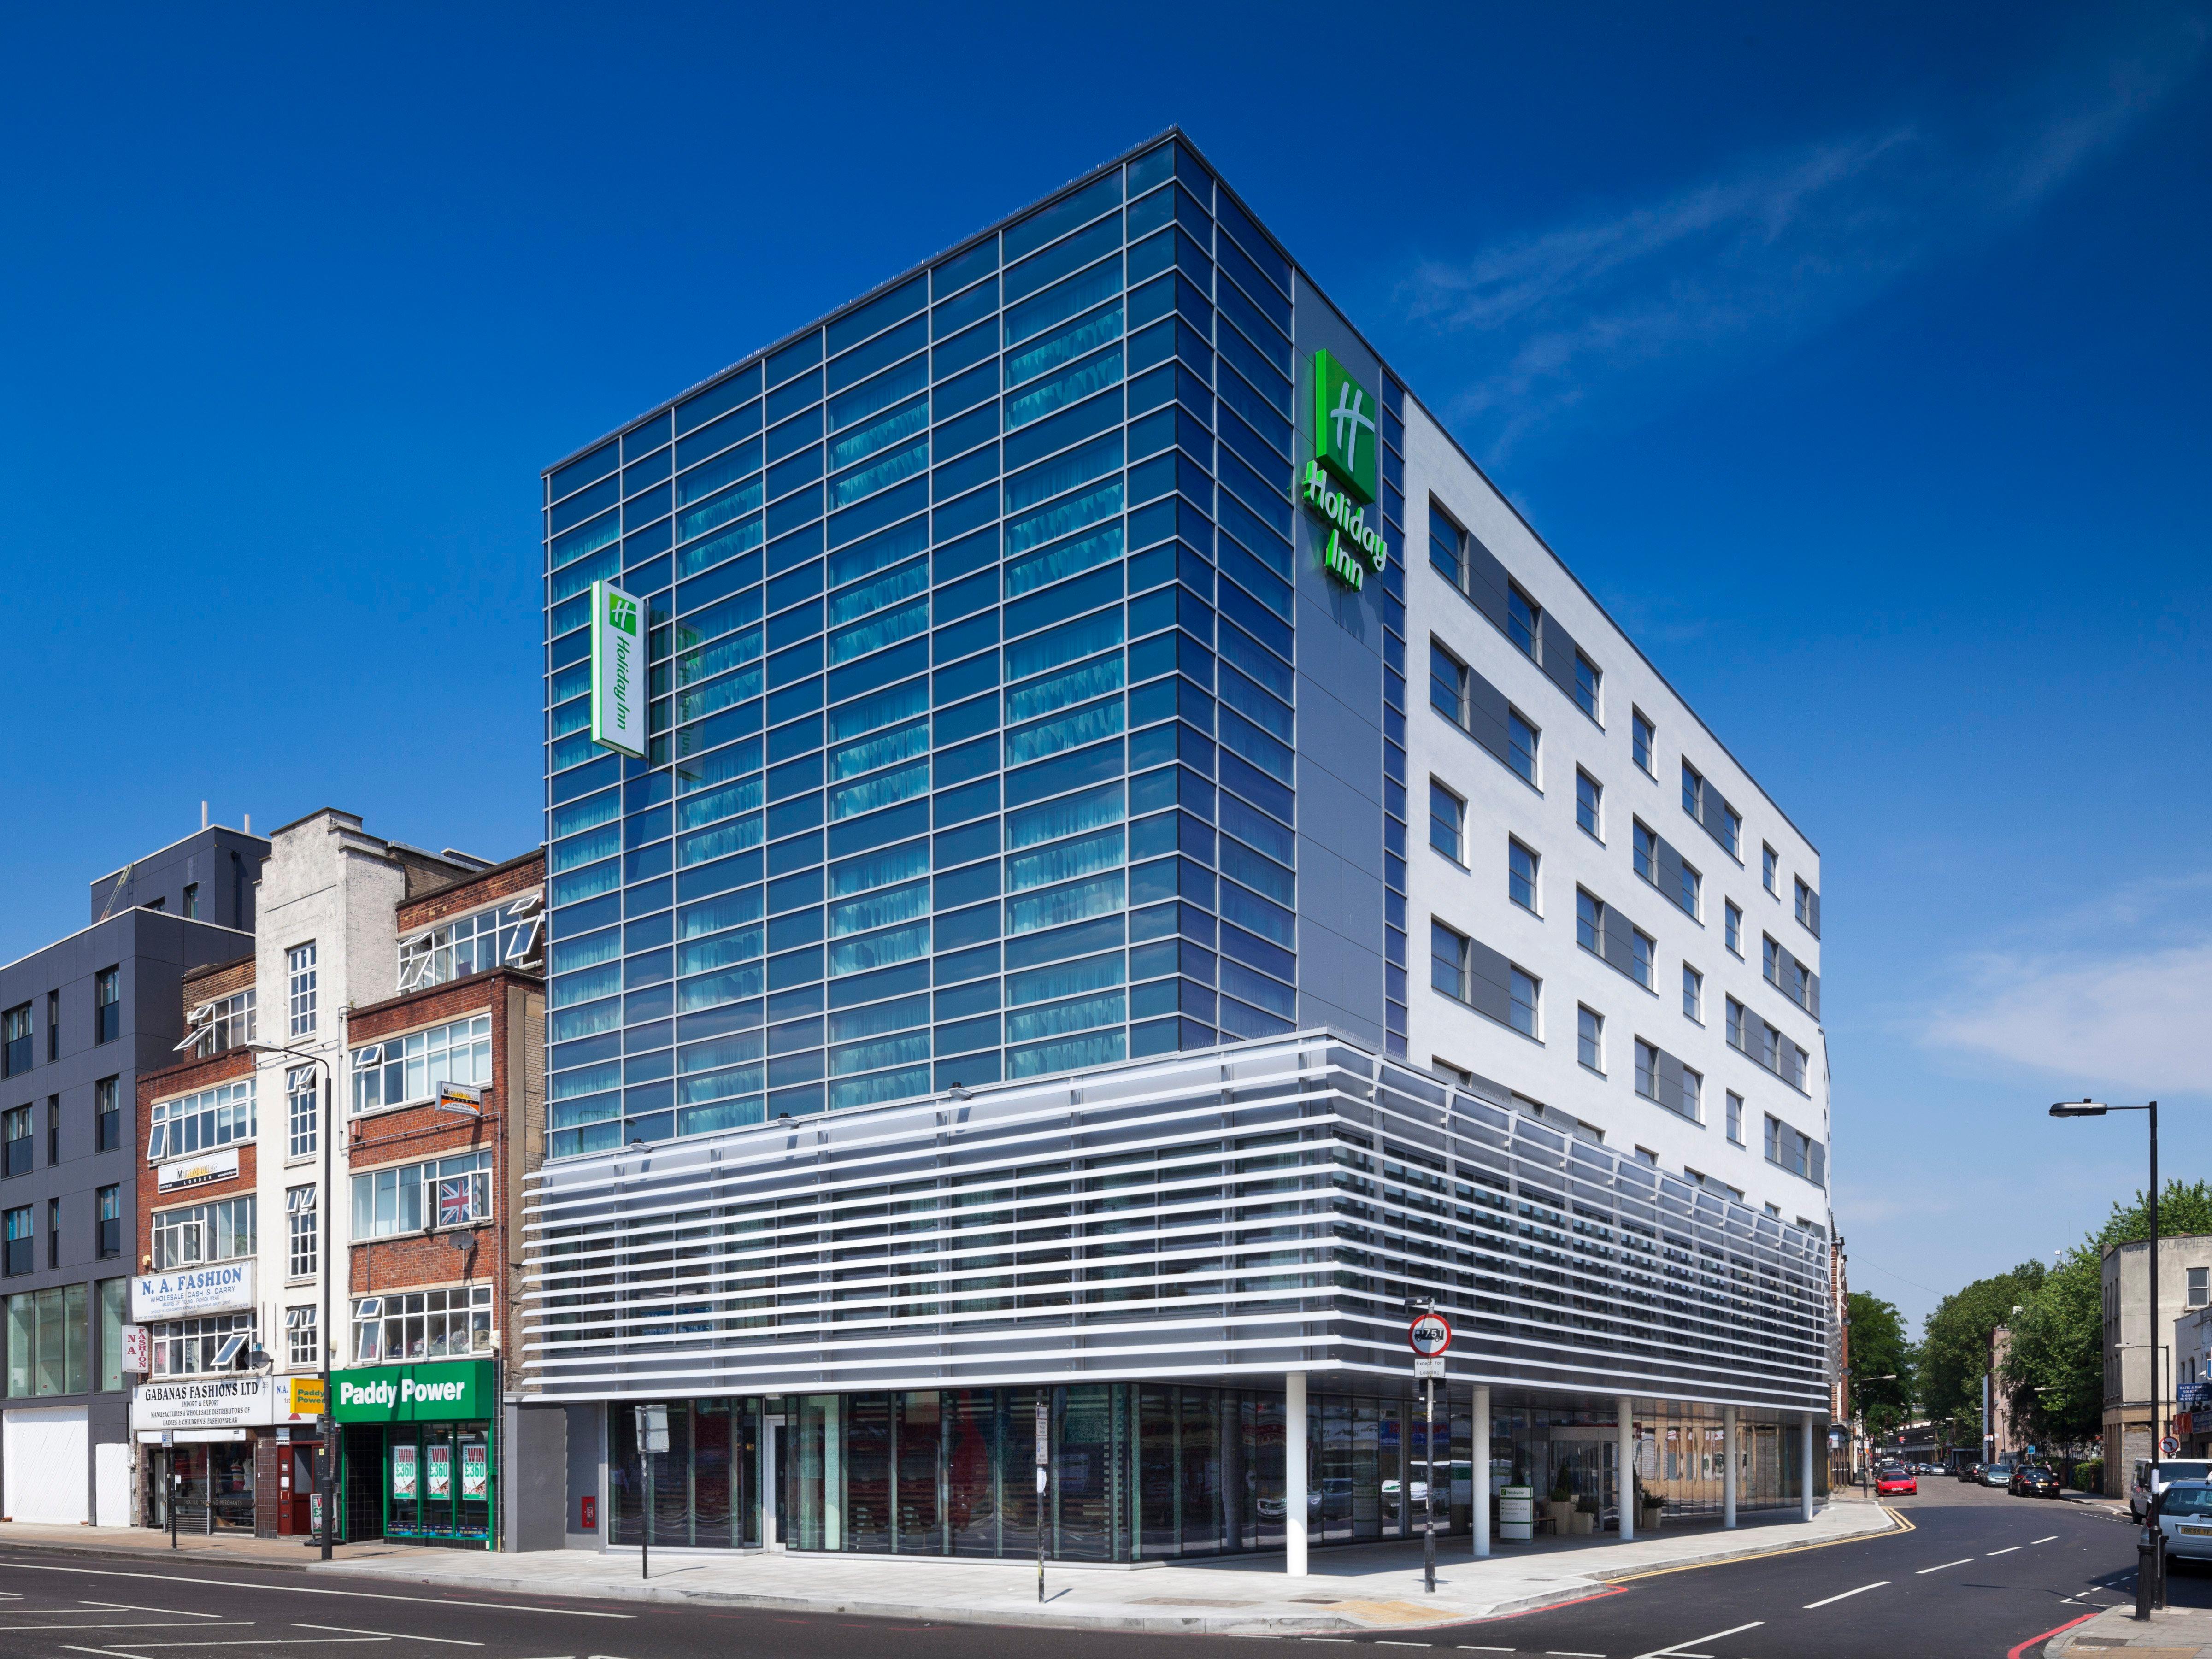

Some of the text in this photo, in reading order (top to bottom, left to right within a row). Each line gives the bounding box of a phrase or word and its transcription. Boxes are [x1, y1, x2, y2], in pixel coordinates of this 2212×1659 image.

[1302, 460, 1388, 572] Holiday
[1327, 529, 1363, 592] Inn
[613, 635, 630, 730] Holiday Inn
[201, 1163, 218, 1175] COLLEGE
[183, 1176, 212, 1185] LONDON
[2125, 1244, 2146, 1255] NOT
[142, 1267, 242, 1295] N. A. FASHION
[150, 1293, 184, 1303] WHOLESALE
[214, 1285, 235, 1294] CARRY
[138, 1328, 147, 1368] FASHION
[145, 1382, 258, 1401] GABANAS FASHIONS LTD
[276, 1385, 288, 1394] N.A.
[297, 1389, 324, 1397] Paddy
[341, 1379, 465, 1408] Paddy Power
[399, 1449, 413, 1462] WIN
[432, 1448, 447, 1462] WIN
[468, 1448, 484, 1462] WIN
[396, 1463, 413, 1477] £360
[429, 1463, 447, 1477] £360
[465, 1463, 484, 1477] £360
